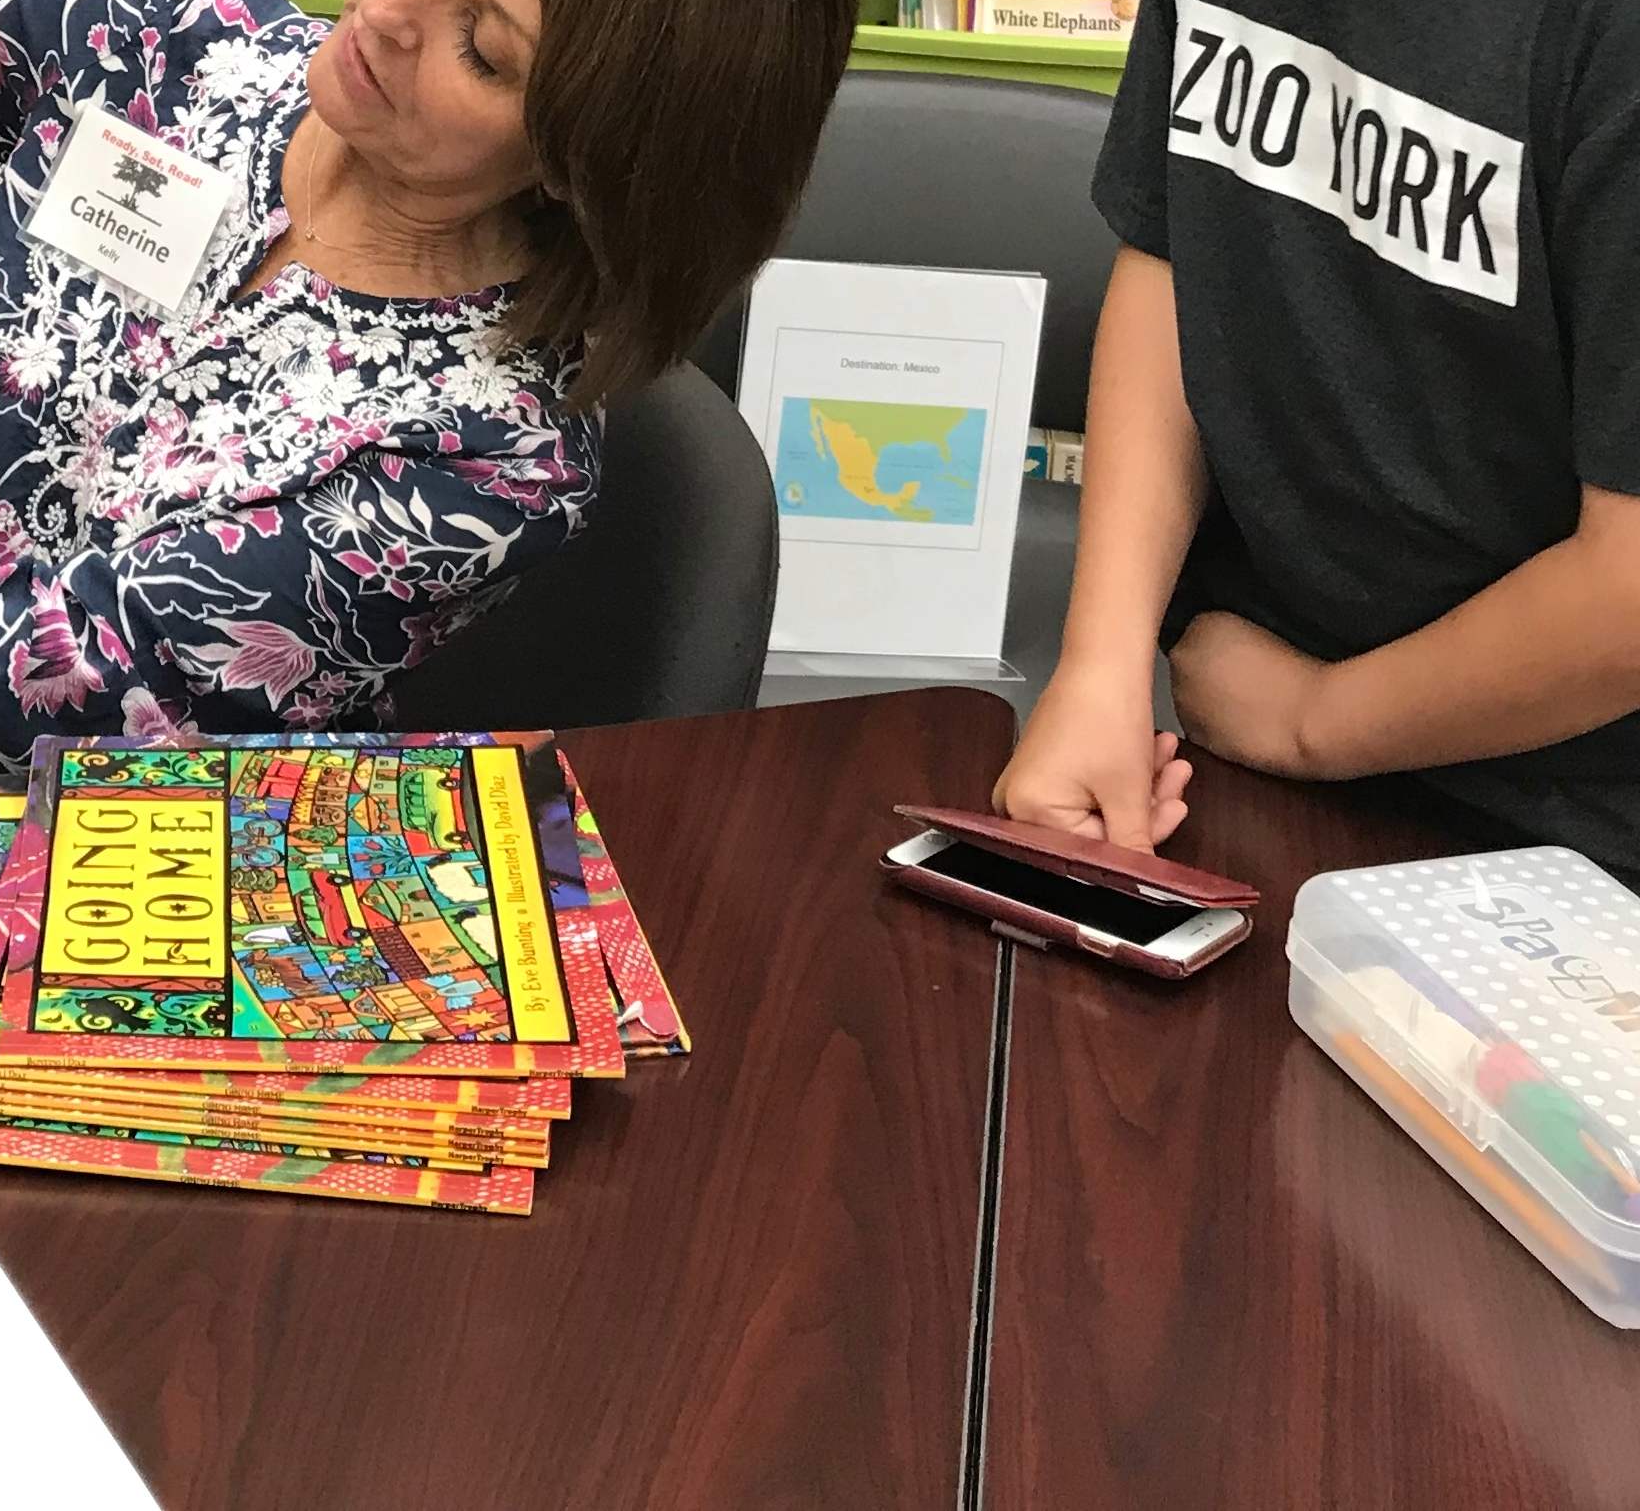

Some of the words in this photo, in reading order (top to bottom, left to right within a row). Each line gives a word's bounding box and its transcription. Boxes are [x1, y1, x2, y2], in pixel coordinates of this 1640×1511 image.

[993, 8, 1038, 27] White
[1043, 11, 1121, 34] Elephants
[1169, 28, 1310, 168] ZOO
[1329, 82, 1499, 275] YORK
[70, 195, 170, 263] Catherine
[97, 243, 121, 264] Kelly
[904, 361, 940, 375] Mexico
[490, 775, 506, 795] Diaz
[495, 796, 513, 829] David
[63, 809, 138, 966] GOING
[143, 811, 213, 968] HOME
[505, 848, 524, 904] Illustrated
[518, 921, 537, 970] Bunting
[522, 969, 542, 992] Eve
[525, 997, 550, 1012] By
